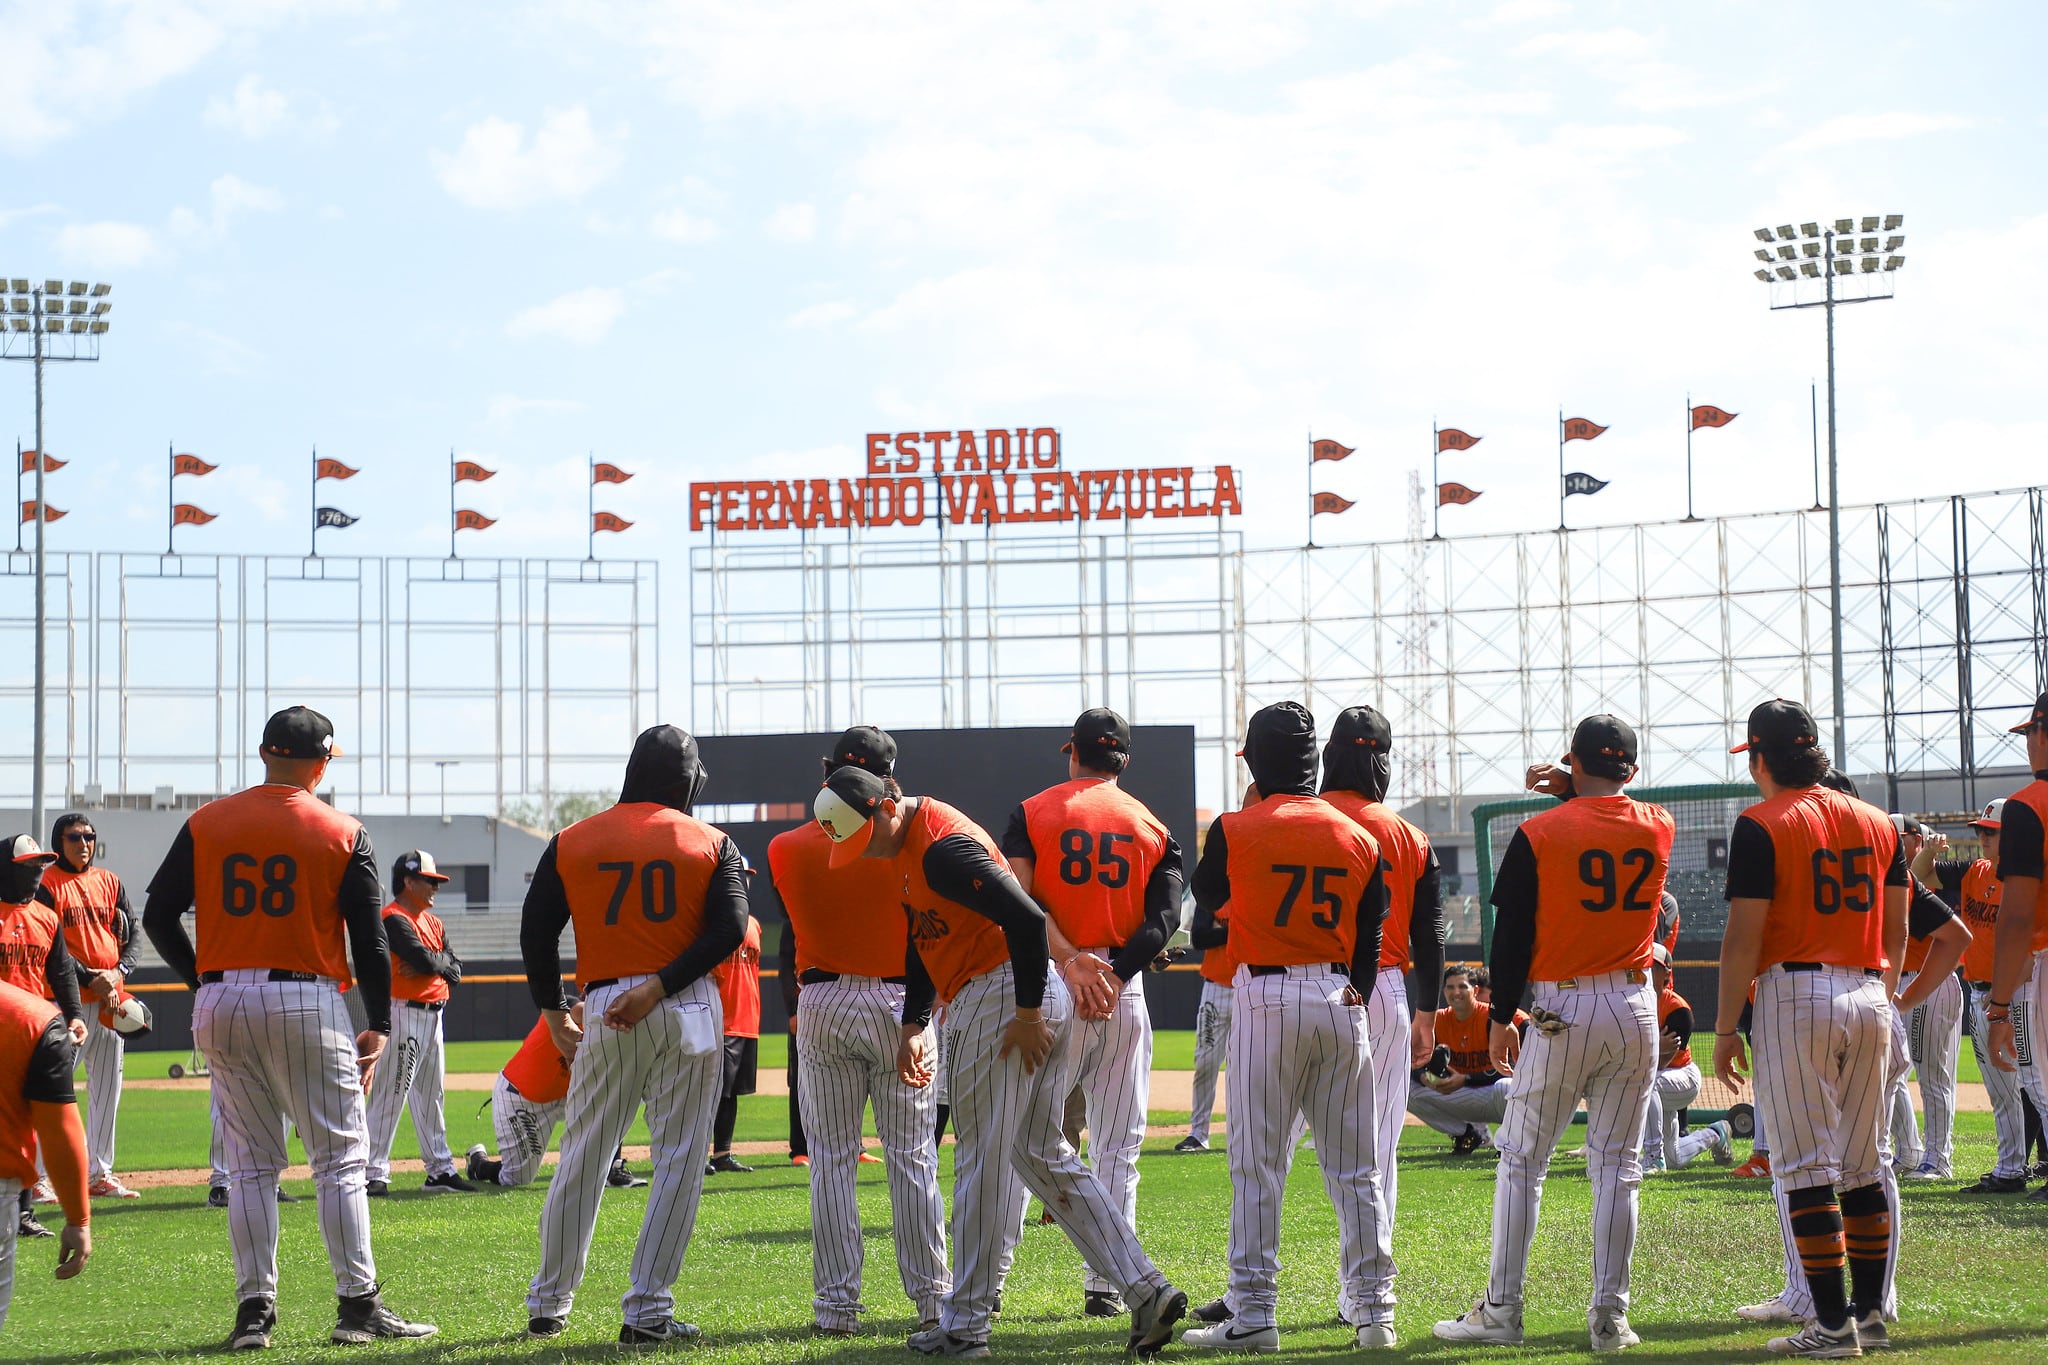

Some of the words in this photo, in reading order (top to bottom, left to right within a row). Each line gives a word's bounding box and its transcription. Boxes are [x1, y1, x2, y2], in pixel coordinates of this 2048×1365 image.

[1574, 423, 1588, 435] 10
[1703, 409, 1718, 422] 24
[183, 459, 200, 471] 64
[326, 463, 342, 474] 75
[867, 427, 1060, 475] ESTADIO
[689, 476, 925, 532] FERNANDO
[938, 465, 1242, 525] VALENZUELA
[1573, 476, 1588, 491] 14
[183, 509, 198, 521] 71
[325, 511, 342, 525] 76
[1059, 828, 1134, 889] 85
[1578, 848, 1656, 913] 92
[1811, 846, 1875, 915] 65
[221, 852, 298, 918] 68
[597, 859, 677, 927] 70
[1271, 864, 1348, 930] 75
[2012, 1005, 2027, 1060] PAQUETEXPRESS
[515, 1108, 543, 1157] Caliente
